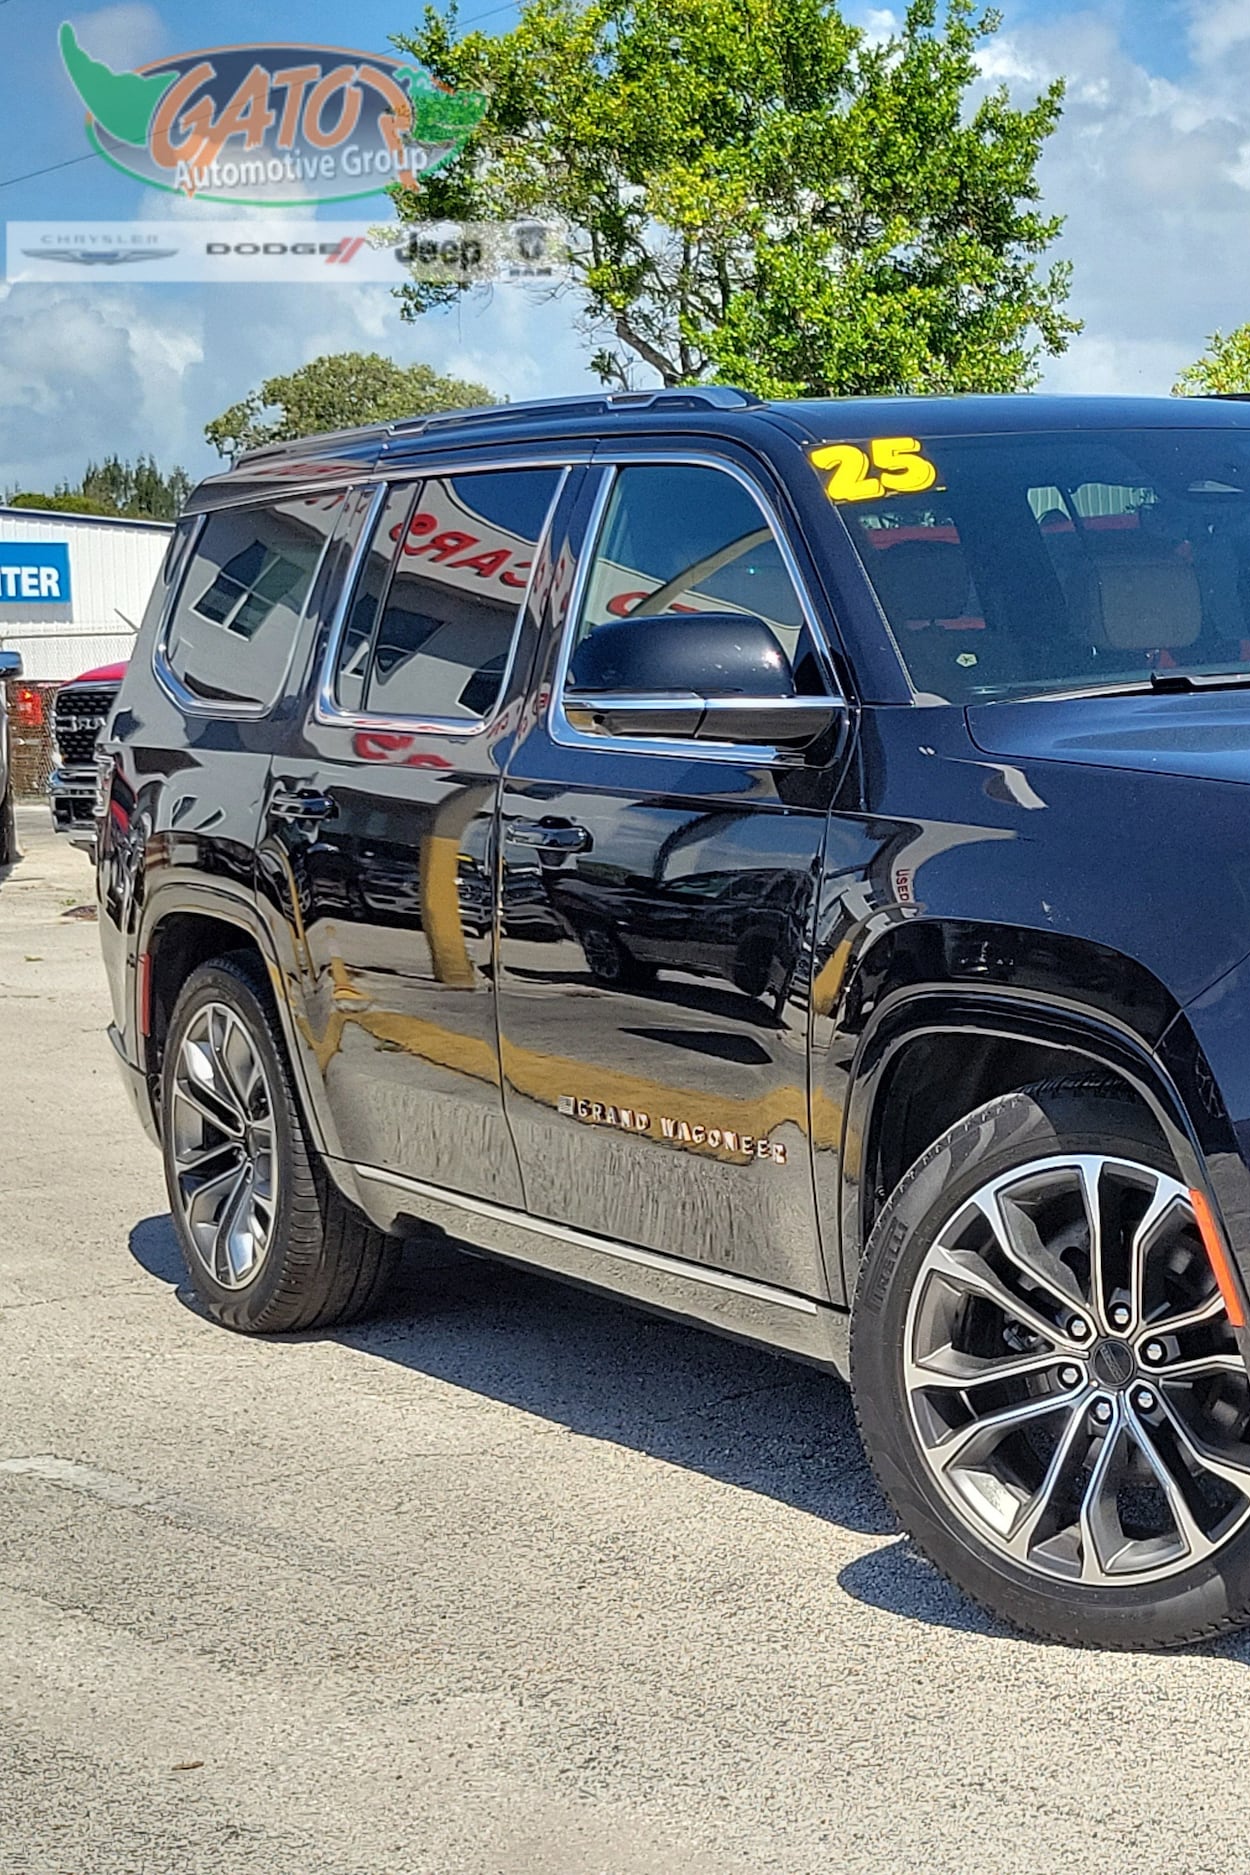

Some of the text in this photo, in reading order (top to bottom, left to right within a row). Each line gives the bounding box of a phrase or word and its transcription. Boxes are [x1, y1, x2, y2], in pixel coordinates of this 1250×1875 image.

[810, 436, 937, 502] 25
[0, 565, 61, 597] TER
[896, 868, 911, 902] USED
[577, 1098, 788, 1165] GRAND WAGONEER
